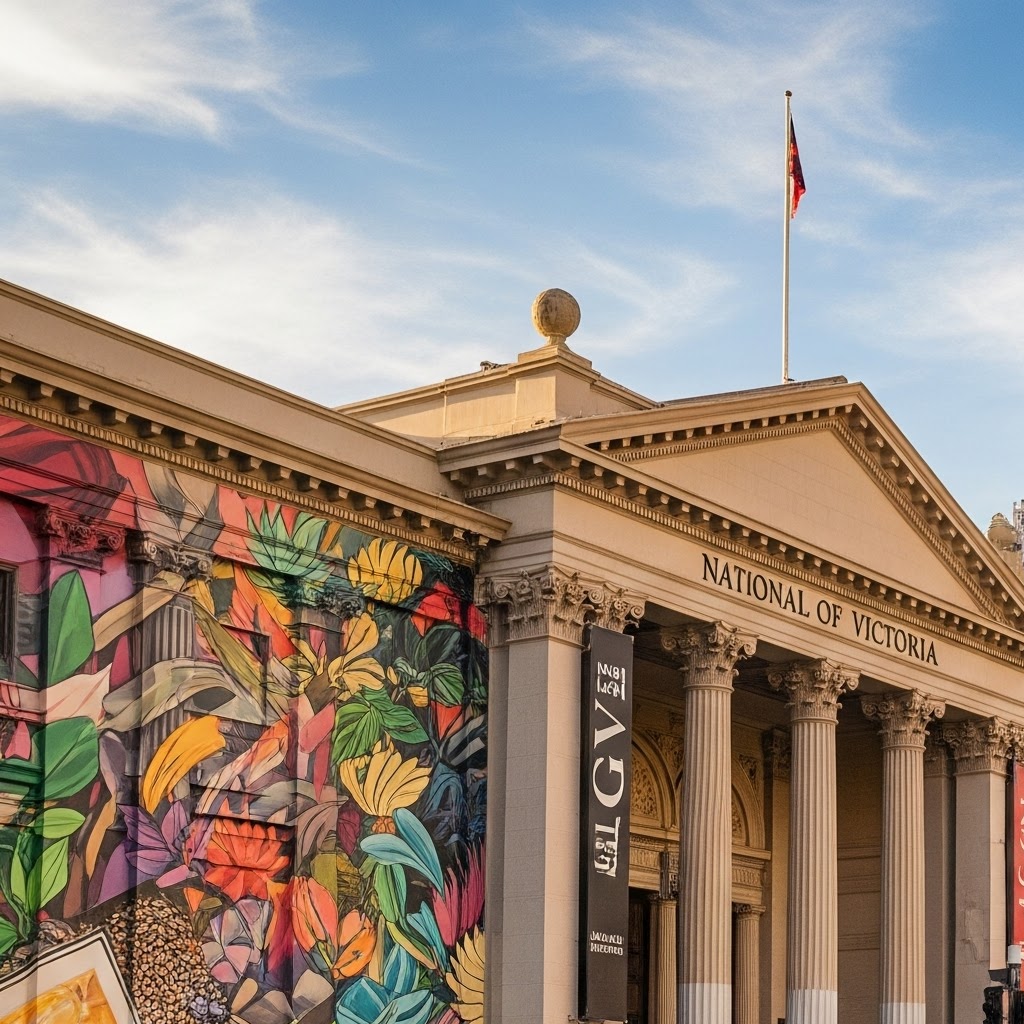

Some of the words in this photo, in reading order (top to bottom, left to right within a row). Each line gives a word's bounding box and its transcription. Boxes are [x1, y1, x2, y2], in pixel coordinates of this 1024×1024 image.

[702, 553, 810, 618] NATIONAL
[816, 599, 842, 628] OF
[852, 610, 939, 666] VICTORIA
